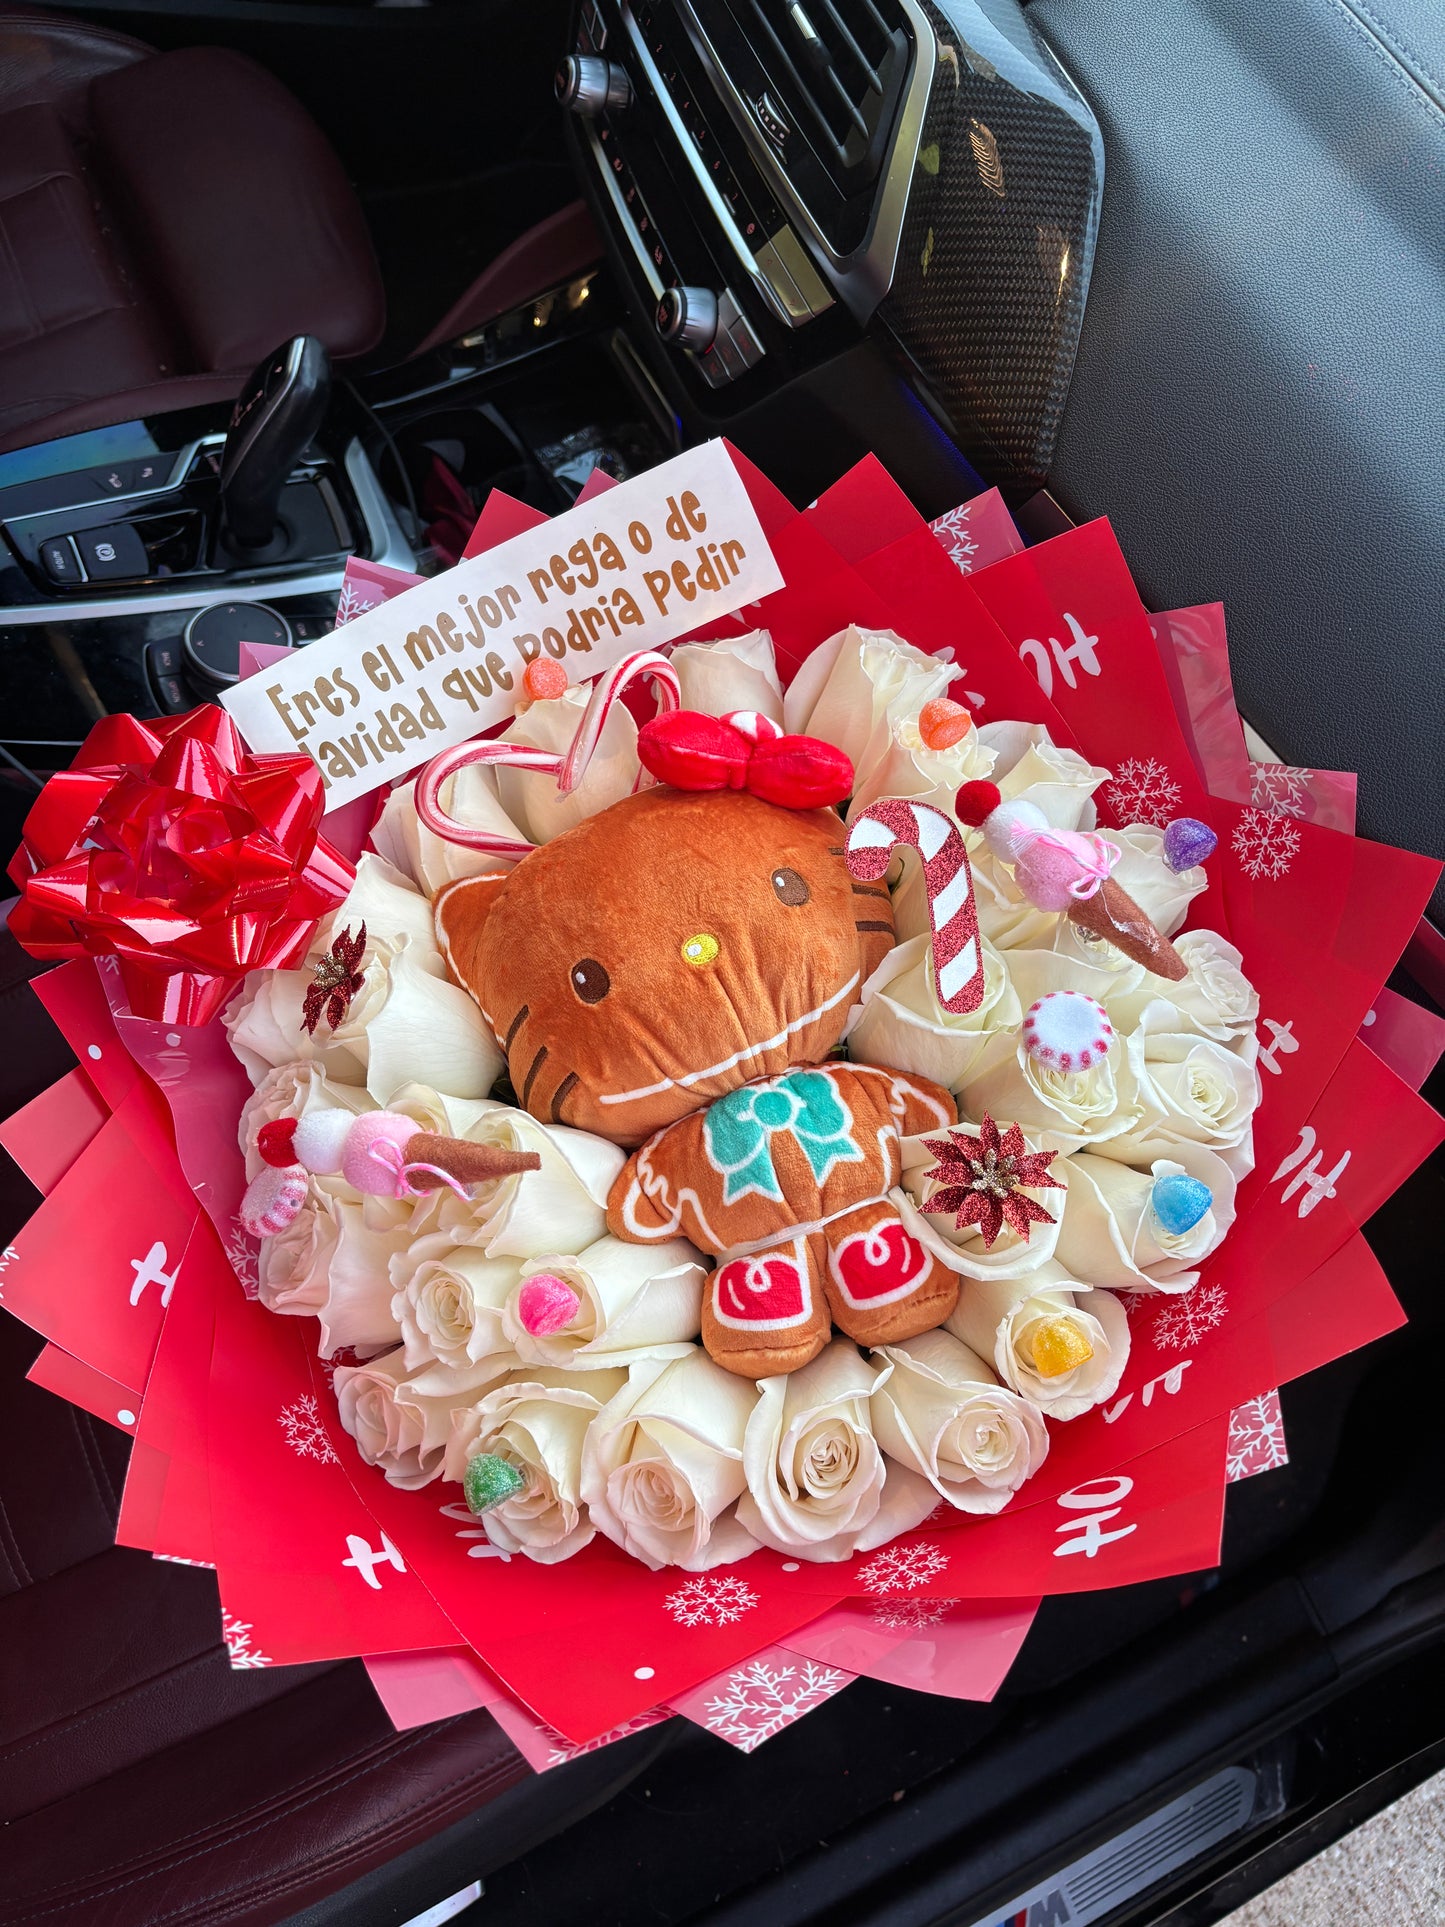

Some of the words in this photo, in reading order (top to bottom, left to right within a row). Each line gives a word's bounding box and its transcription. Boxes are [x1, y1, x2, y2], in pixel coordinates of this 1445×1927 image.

[265, 667, 361, 742] Eres
[361, 643, 405, 692] el
[404, 584, 522, 672] mejor
[527, 532, 627, 605] rega
[666, 490, 707, 542] de
[441, 651, 515, 713] que
[512, 588, 646, 666] podria
[642, 539, 747, 617] pedir
[1053, 1475, 1138, 1558] HO
